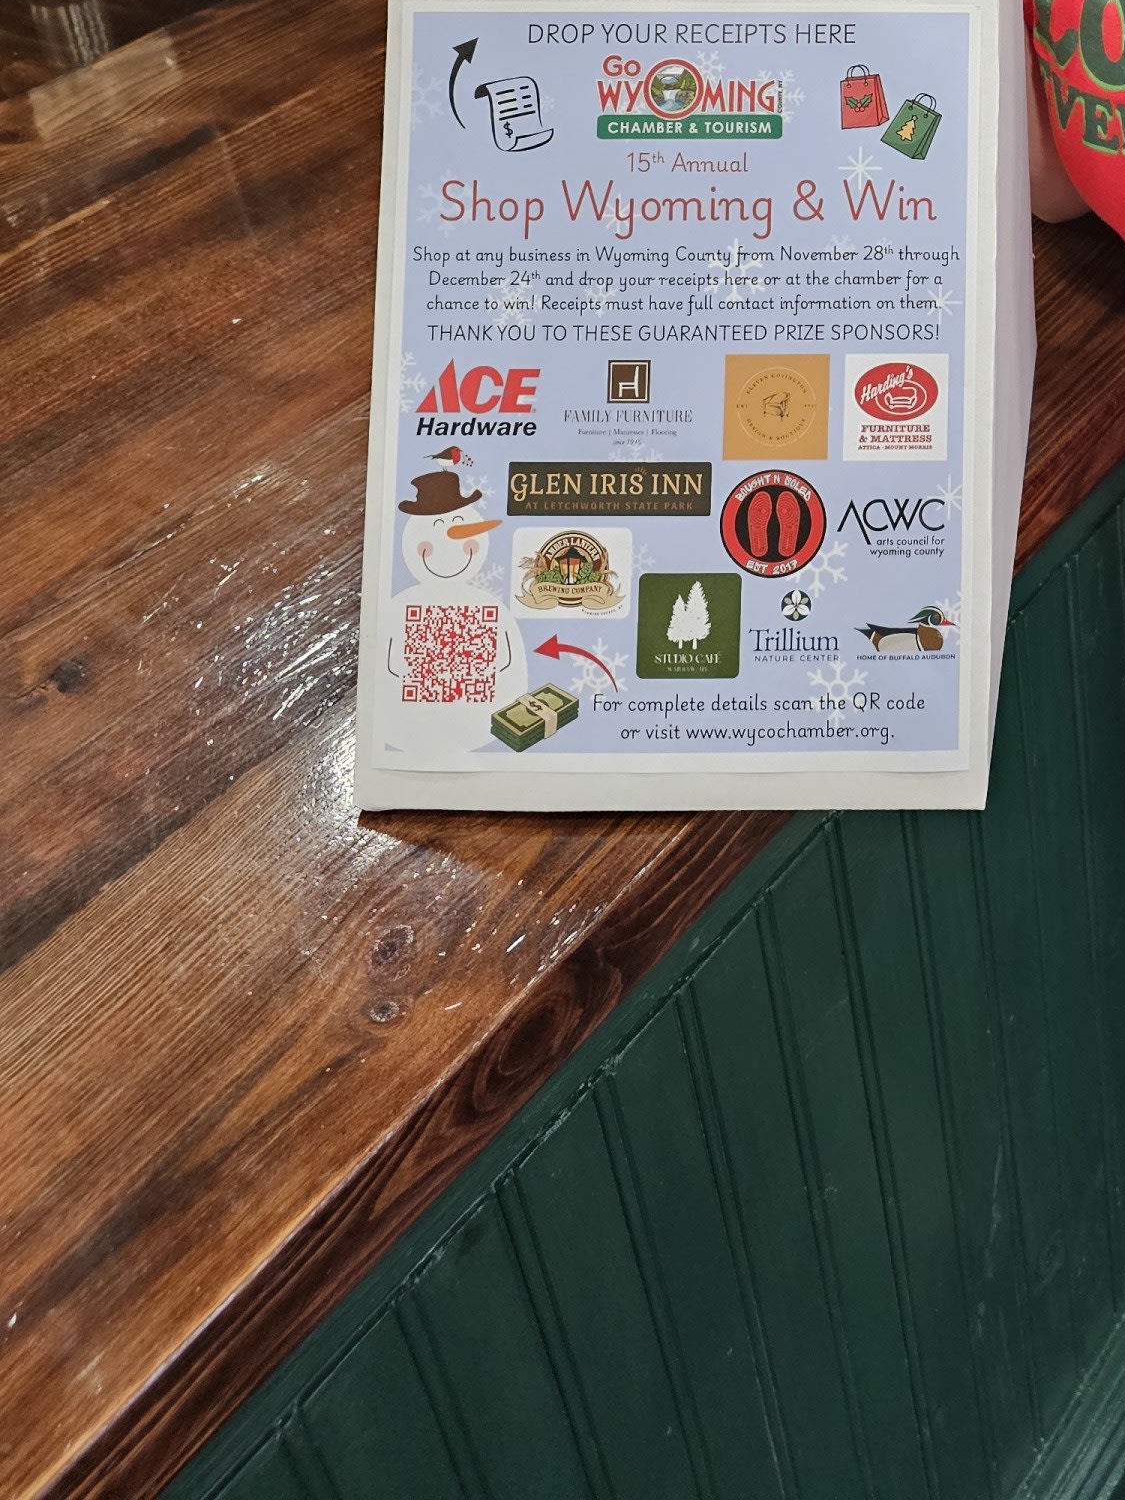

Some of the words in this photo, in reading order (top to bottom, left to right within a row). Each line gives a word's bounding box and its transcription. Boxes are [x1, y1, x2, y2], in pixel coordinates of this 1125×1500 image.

[528, 23, 595, 44] DROP
[600, 23, 668, 44] YOUR
[676, 23, 787, 44] RECEIPTS
[795, 23, 856, 44] HERE
[602, 54, 642, 77] Go
[597, 58, 775, 119] WYOMING
[607, 121, 683, 134] CHAMBER
[688, 122, 698, 134] &
[704, 121, 772, 134] TOURISM
[627, 151, 665, 173] 15th
[671, 151, 749, 173] Annual
[441, 179, 544, 240] Shop
[561, 179, 773, 241] Wyoming
[792, 179, 825, 222] &
[842, 179, 935, 222] Win
[412, 245, 451, 268] Shop
[455, 249, 471, 262] at
[475, 252, 504, 268] any
[509, 245, 571, 262] business
[576, 248, 591, 262] in
[595, 245, 669, 268] Wyoming
[675, 245, 731, 268] County
[735, 245, 775, 268] from
[780, 245, 859, 261] November
[863, 245, 894, 261] 28th
[898, 244, 960, 268] through
[429, 270, 506, 286] December
[509, 269, 541, 286] 24th
[545, 270, 575, 286] and
[578, 270, 614, 293] drop
[619, 276, 656, 293] your
[658, 272, 720, 293] receipts
[724, 270, 759, 286] here
[763, 276, 782, 286] or
[785, 273, 801, 286] at
[805, 269, 830, 286] the
[834, 269, 902, 285] chamber
[904, 269, 930, 292] for
[933, 275, 943, 285] a
[426, 294, 480, 310] chance
[483, 298, 499, 311] to
[503, 294, 535, 310] win!
[541, 294, 602, 317] Receipts
[604, 298, 644, 311] must
[648, 294, 684, 311] have
[686, 294, 713, 317] full
[718, 297, 775, 310] contact
[780, 293, 872, 317] information
[876, 300, 896, 310] on
[899, 293, 942, 310] them.
[427, 324, 493, 342] THANK
[496, 324, 536, 342] YOU
[541, 324, 567, 342] TO
[572, 324, 633, 342] THESE
[638, 324, 768, 342] GUARANTEED
[774, 324, 825, 341] PRIZE
[830, 323, 939, 341] SPONSORS!
[415, 357, 541, 414] ACE
[859, 364, 914, 405] Harding's
[416, 417, 537, 437] Hardware
[564, 409, 610, 423] FAMILY
[616, 409, 693, 423] FURNITURE
[858, 434, 868, 443] &
[870, 434, 932, 443] MATTRESS
[861, 424, 931, 433] FURNITURE
[510, 473, 582, 501] GLEN
[589, 473, 644, 495] IRIS
[650, 473, 703, 495] INN
[735, 474, 771, 502] BOUGHT
[773, 474, 781, 484] N
[525, 501, 538, 510] AT
[544, 501, 620, 510] LETCHWORTH
[625, 501, 659, 511] STATE
[664, 502, 693, 510] PARK
[836, 498, 946, 546] ACWC
[876, 536, 894, 546] arts
[896, 535, 929, 546] council
[931, 535, 945, 546] for
[869, 547, 912, 557] wyoming
[913, 547, 945, 558] county
[772, 559, 798, 575] 2017
[537, 584, 570, 594] BREWING
[571, 585, 603, 595] COMPANY
[748, 627, 840, 652] Trillium
[654, 653, 693, 665] STUDIO
[754, 654, 794, 663] NATURE
[799, 654, 839, 662] CENTER
[593, 694, 623, 712] For
[628, 693, 705, 719] complete
[711, 692, 768, 712] details
[773, 699, 814, 711] scan
[818, 692, 846, 710] the
[852, 691, 881, 713] QR
[886, 691, 925, 710] code
[620, 728, 641, 740] or
[645, 724, 681, 740] visit
[685, 721, 895, 746] www.wycochamber.org.
